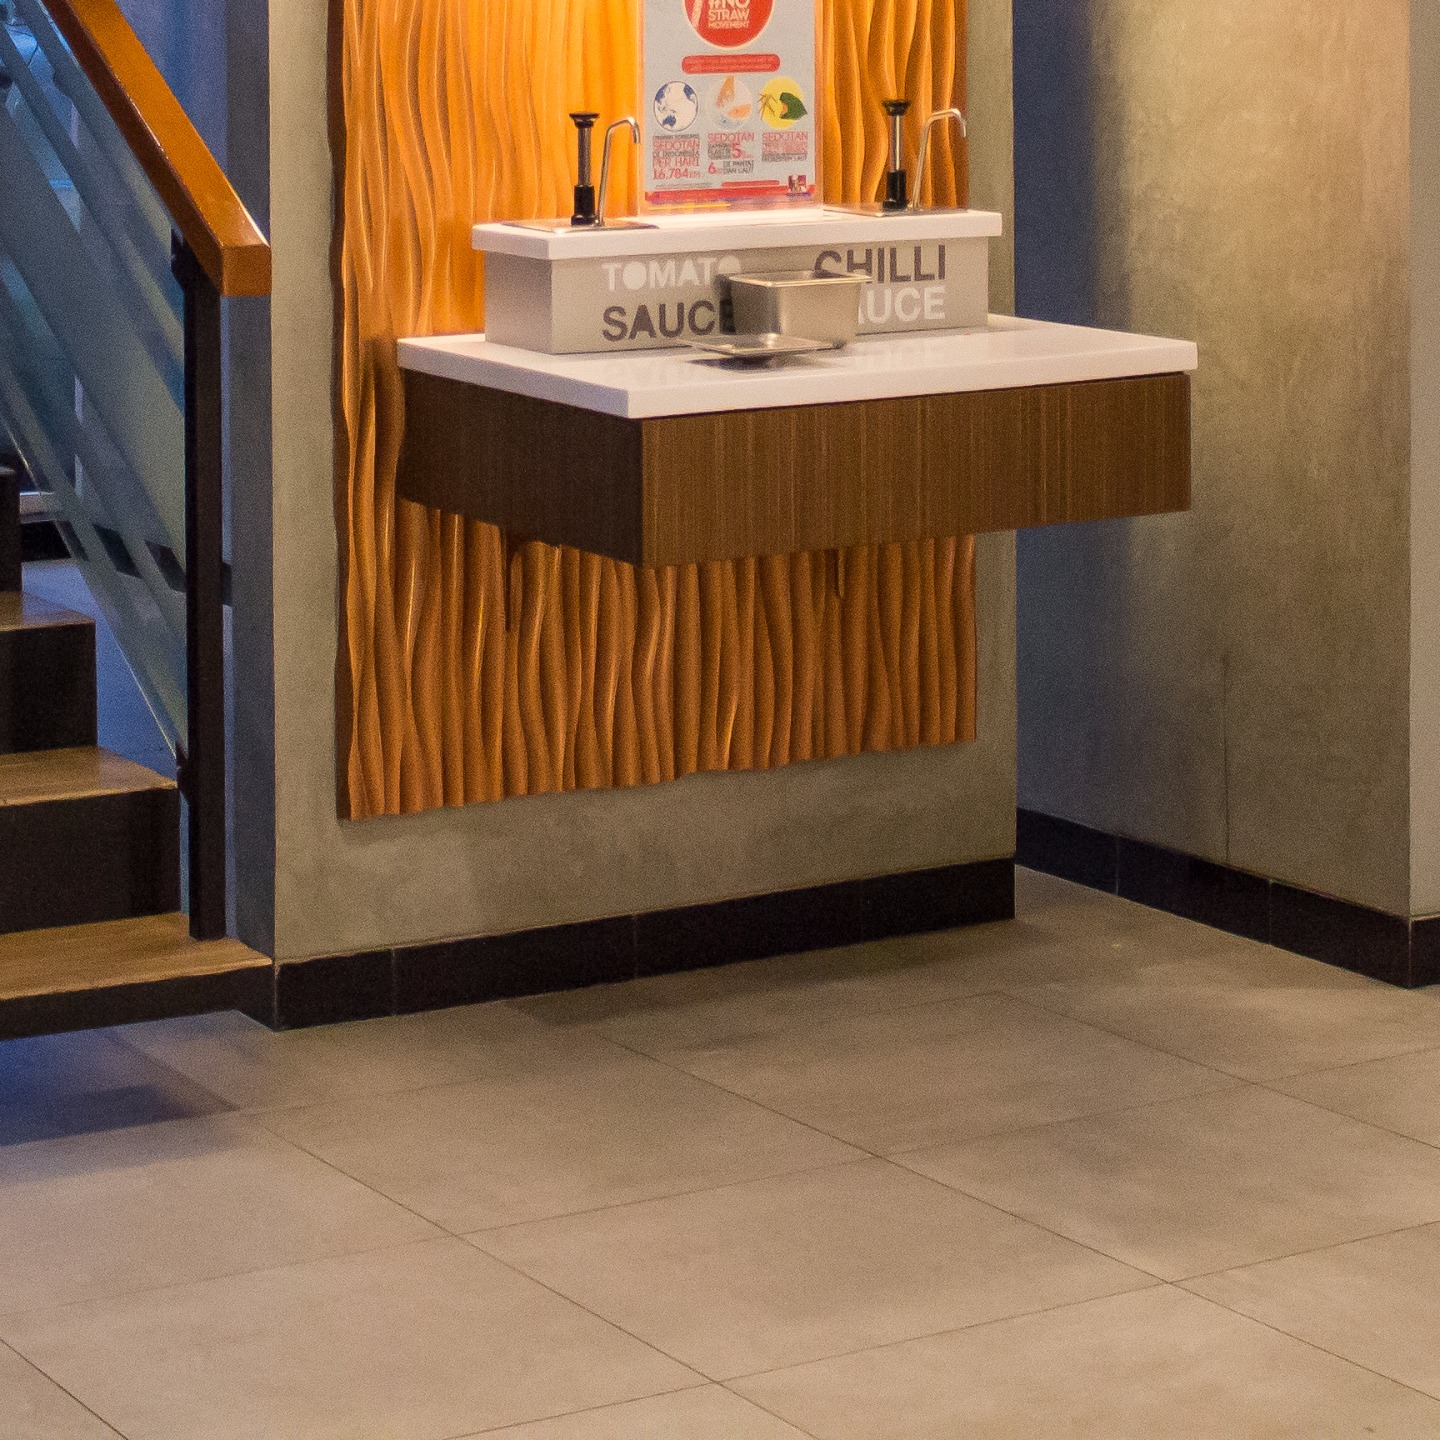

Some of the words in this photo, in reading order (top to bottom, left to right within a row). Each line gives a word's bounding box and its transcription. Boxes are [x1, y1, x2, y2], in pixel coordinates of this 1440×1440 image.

[708, 8, 750, 22] STRAW
[708, 21, 750, 30] MOVEMENT
[707, 131, 755, 142] SEDOTAN
[762, 131, 808, 142] SEDOTAN
[653, 138, 701, 152] SEDOTAN
[675, 156, 700, 167] HARI
[708, 162, 717, 175] 6
[814, 244, 946, 284] CHILLI
